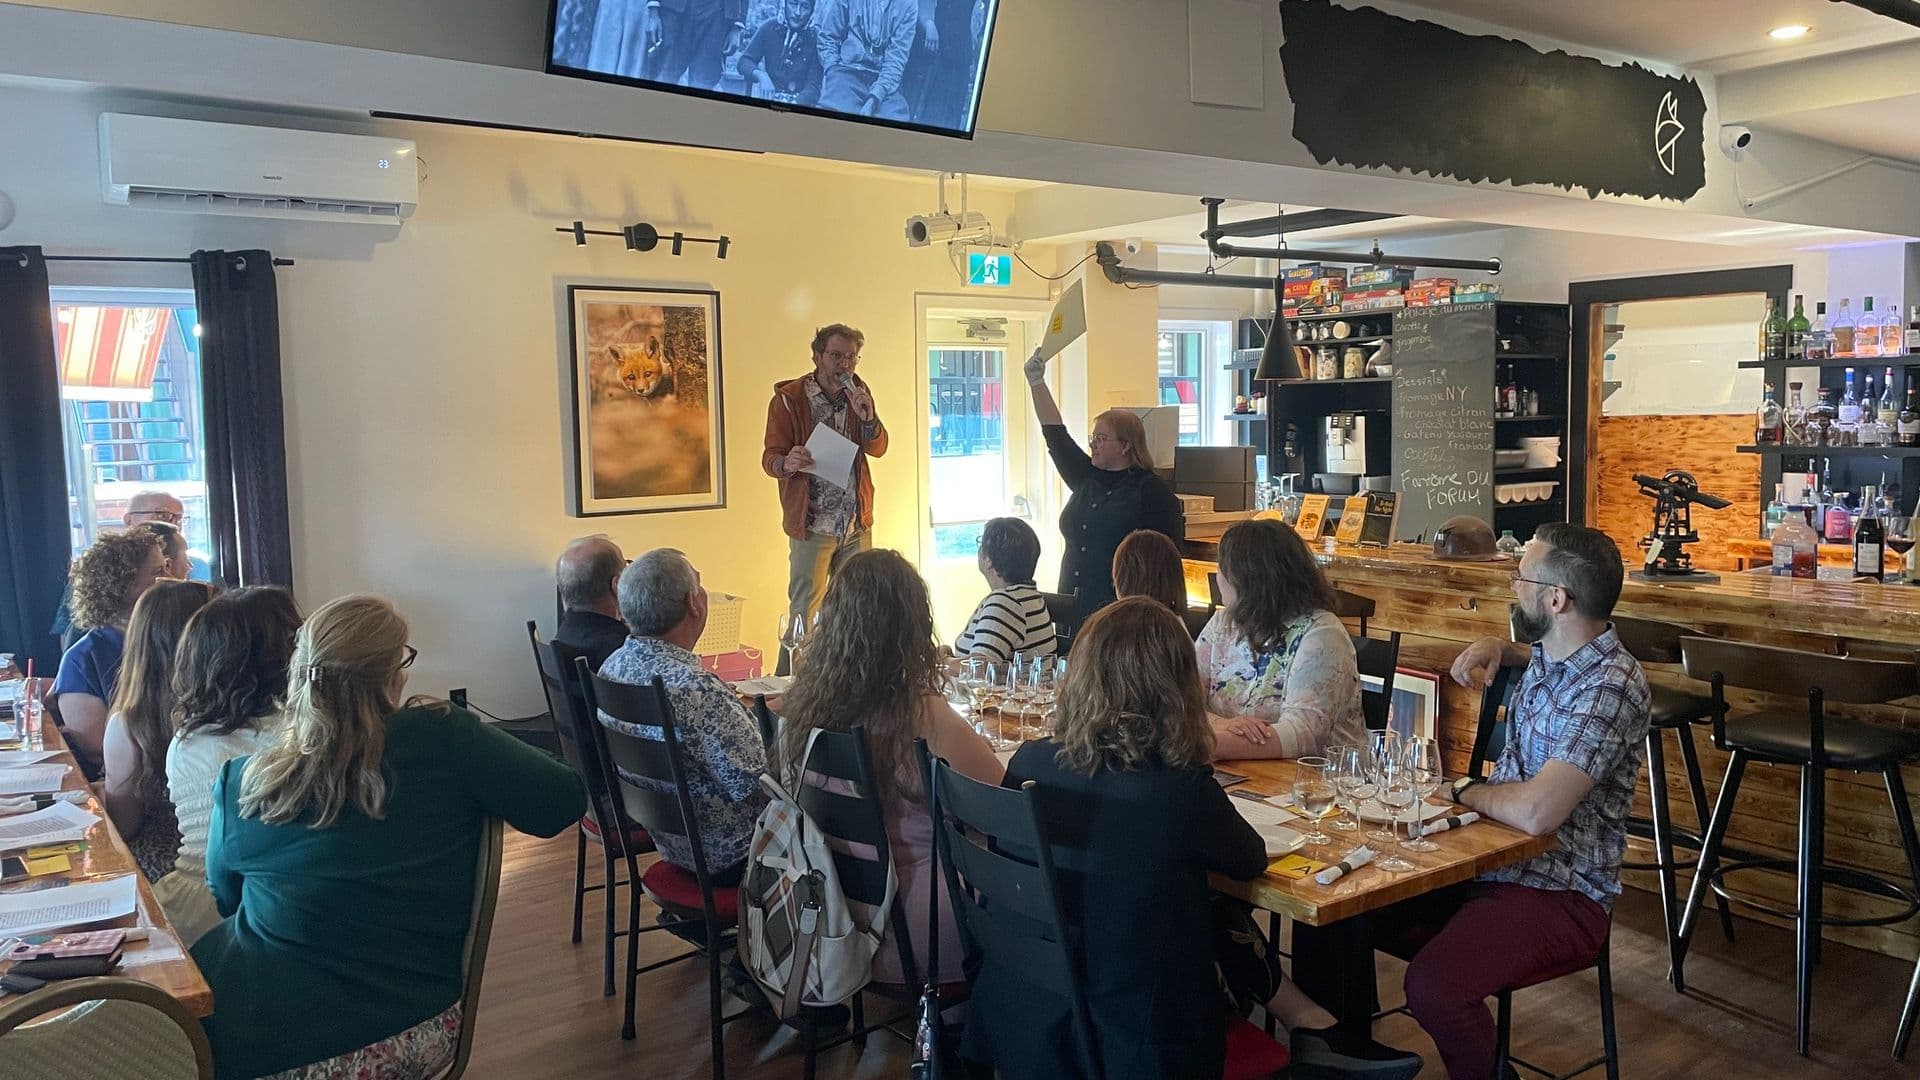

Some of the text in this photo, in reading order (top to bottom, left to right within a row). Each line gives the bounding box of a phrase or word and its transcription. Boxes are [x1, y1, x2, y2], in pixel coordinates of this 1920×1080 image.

[378, 159, 389, 169] 23
[1440, 302, 1452, 313] du
[1446, 385, 1469, 401] NY
[1426, 487, 1482, 510] FORUM
[1290, 865, 1312, 875] A
